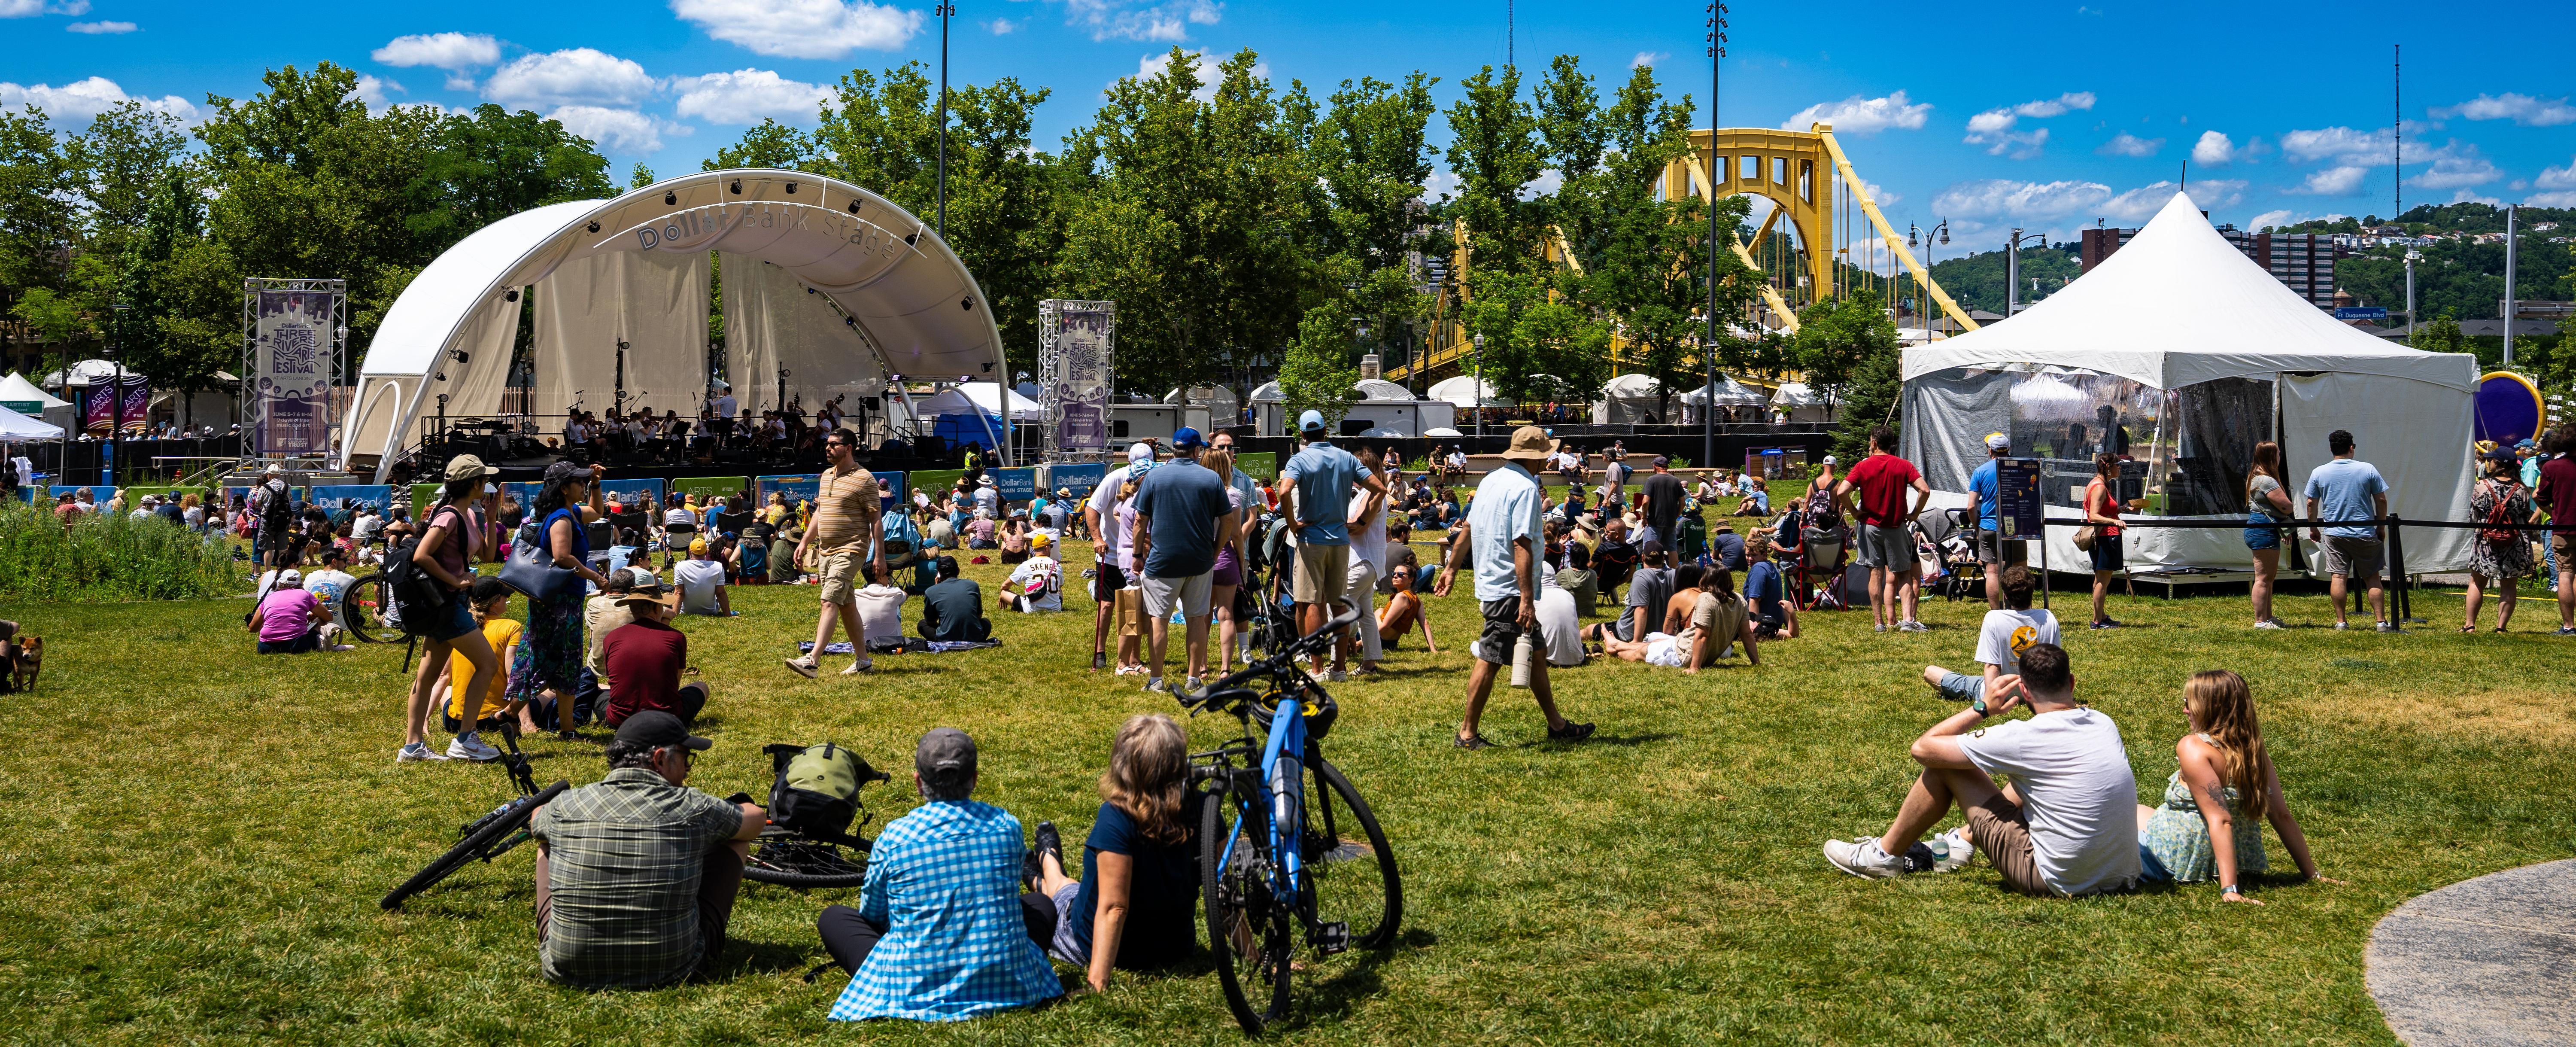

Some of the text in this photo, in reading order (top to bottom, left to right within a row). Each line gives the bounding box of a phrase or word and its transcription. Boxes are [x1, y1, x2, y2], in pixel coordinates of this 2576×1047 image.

[637, 206, 896, 260] Dollar Bank Stage
[274, 329, 316, 340] THREE
[1070, 343, 1097, 352] THREE
[292, 347, 315, 363] ARTS
[1081, 358, 1097, 371] ARTS
[91, 386, 113, 408] ARTS
[125, 386, 146, 408] ARTS
[90, 397, 112, 417] LANDING
[123, 397, 145, 417] LANDING
[1245, 467, 1270, 476] LANDING
[1057, 474, 1100, 486] DollarBank
[687, 487, 713, 495] ARTS
[921, 483, 943, 492] ARTS
[319, 497, 382, 509] Dollank
[1030, 563, 1057, 572] SKENES
